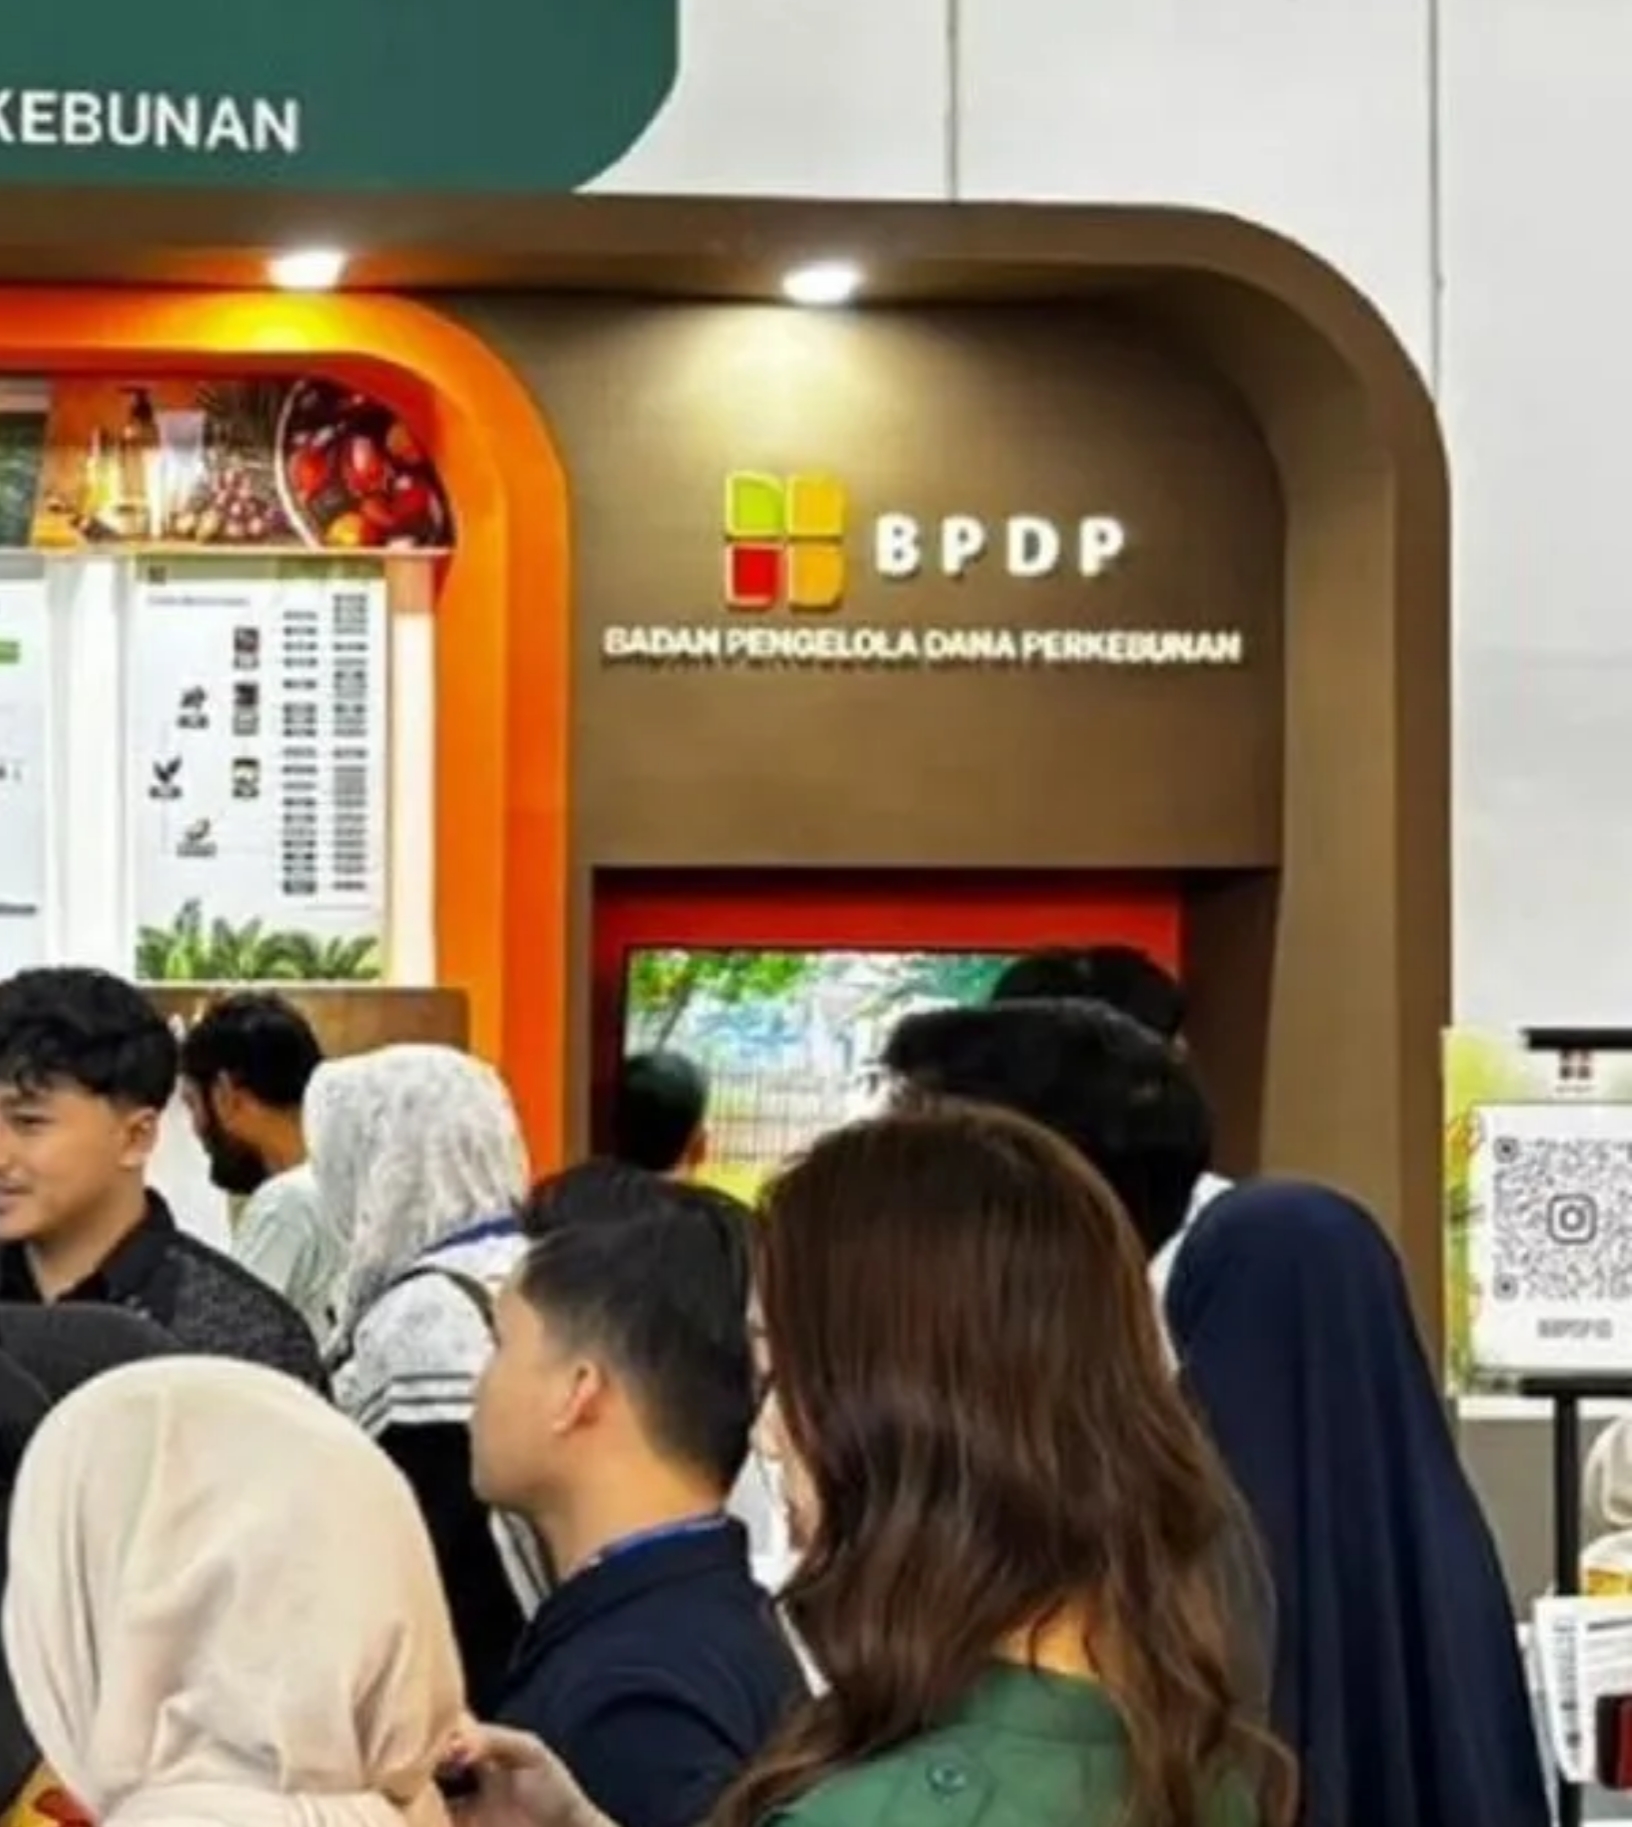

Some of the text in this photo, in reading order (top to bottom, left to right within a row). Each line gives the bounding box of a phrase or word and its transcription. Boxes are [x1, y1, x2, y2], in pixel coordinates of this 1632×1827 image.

[603, 626, 1242, 664] BADAN PENGELOLA DANA PERKEBUNAN
